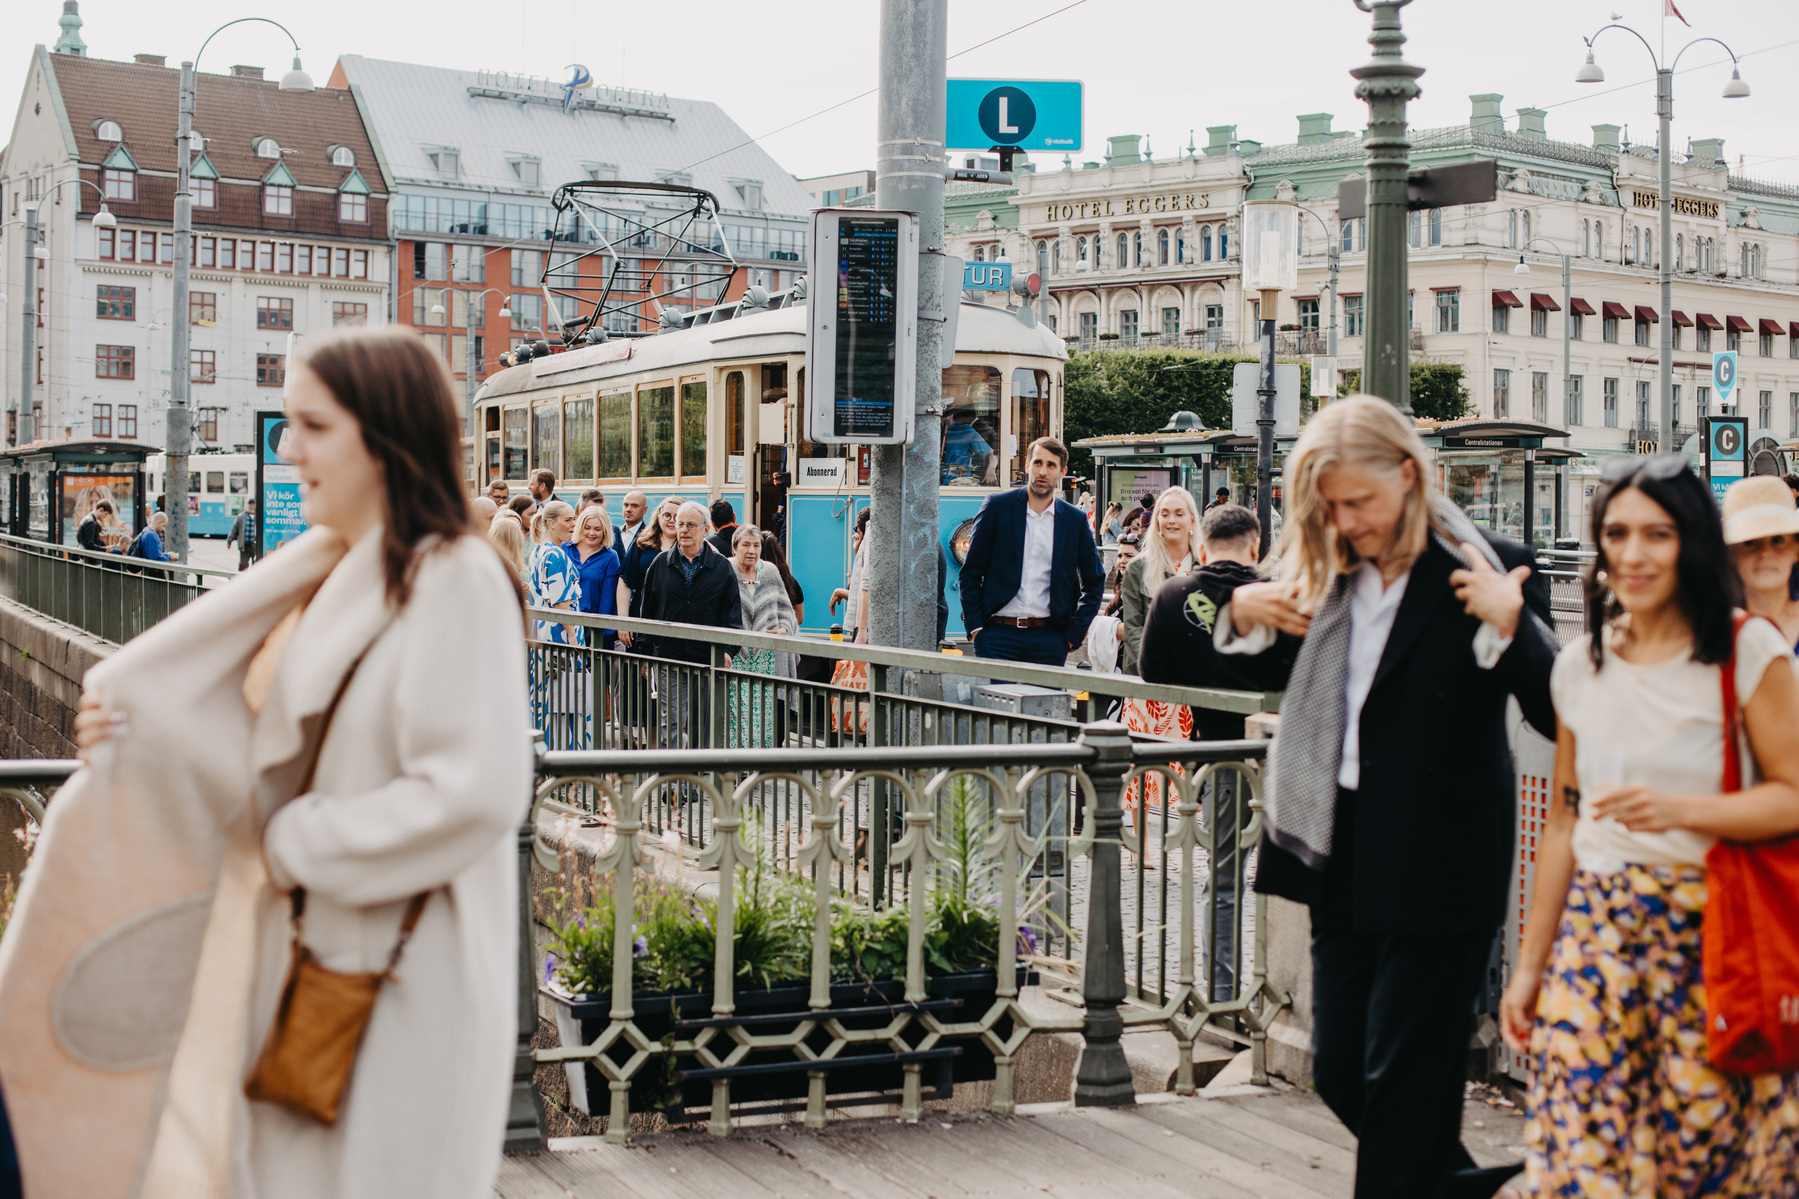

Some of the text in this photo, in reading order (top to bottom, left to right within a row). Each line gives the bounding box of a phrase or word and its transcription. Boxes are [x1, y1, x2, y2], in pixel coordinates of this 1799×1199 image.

[999, 96, 1018, 133] L
[1046, 193, 1208, 222] HOTEL EGGERS
[1675, 197, 1719, 218] EGGERS
[1720, 361, 1730, 382] C
[1465, 438, 1504, 447] Centralstationen
[1721, 429, 1734, 450] C
[1637, 440, 1660, 455] HOT
[807, 466, 838, 477] Abonnerad
[266, 491, 295, 500] Vi kör
[266, 499, 285, 508] inte
[266, 507, 299, 518] vanligt
[265, 516, 307, 525] sommar.
[841, 680, 867, 691] MAXI
